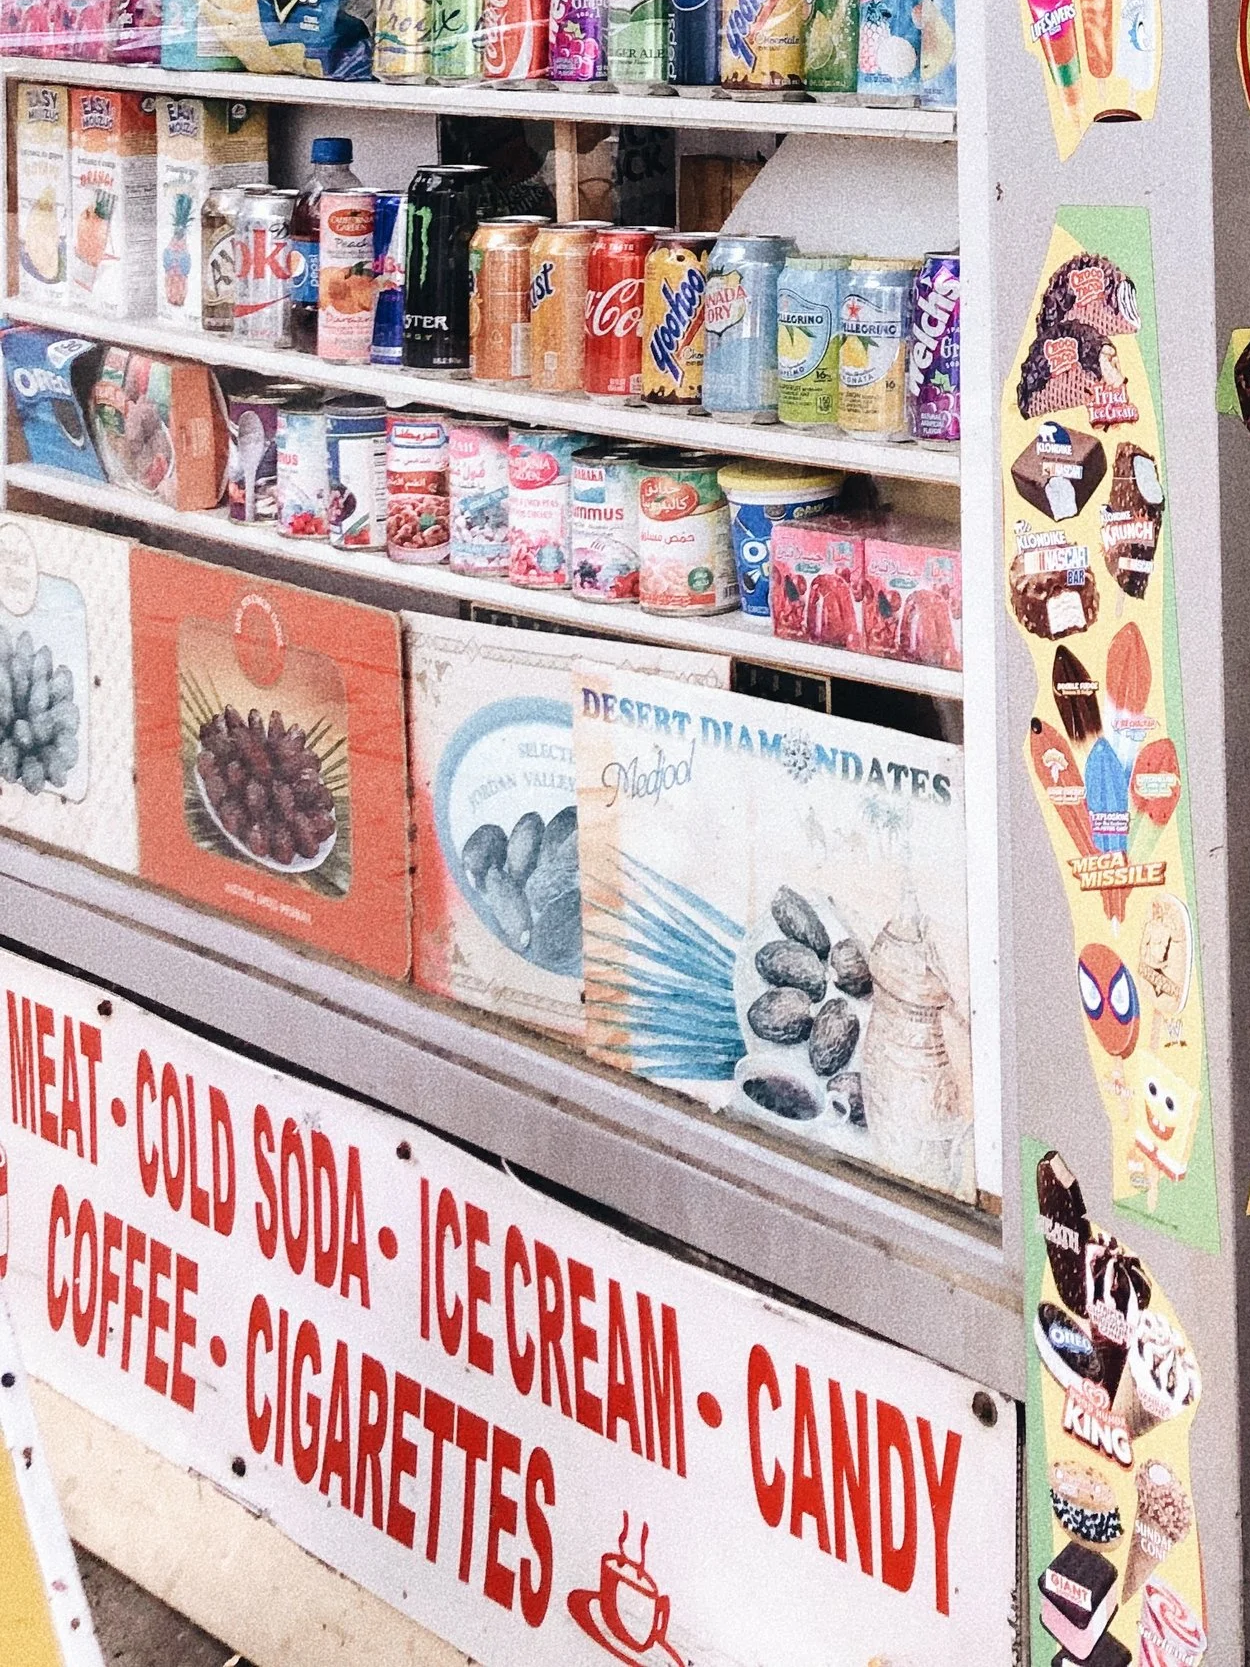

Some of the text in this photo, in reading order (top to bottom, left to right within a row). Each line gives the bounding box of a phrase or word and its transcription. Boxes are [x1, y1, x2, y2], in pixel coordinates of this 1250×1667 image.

[639, 46, 665, 59] ALE
[668, 12, 678, 81] pepsi
[81, 96, 110, 117] EASY
[310, 253, 319, 288] pepsi
[707, 303, 732, 321] DRY
[14, 368, 72, 399] OREO
[1016, 530, 1067, 553] KLONDIKE
[1066, 570, 1086, 586] BAR
[580, 686, 691, 737] DESERT
[601, 737, 697, 808] Medjool
[467, 770, 517, 813] JORDAN
[1071, 852, 1126, 873] MEGA
[1080, 861, 1166, 888] MISSILE
[6, 989, 963, 1618] MEAT COLD SODA ICE CREAM CANDY
[46, 1184, 556, 1629] COFFEE CIGARETTES
[1063, 1397, 1134, 1466] KING
[1051, 1573, 1091, 1603] GIANT
